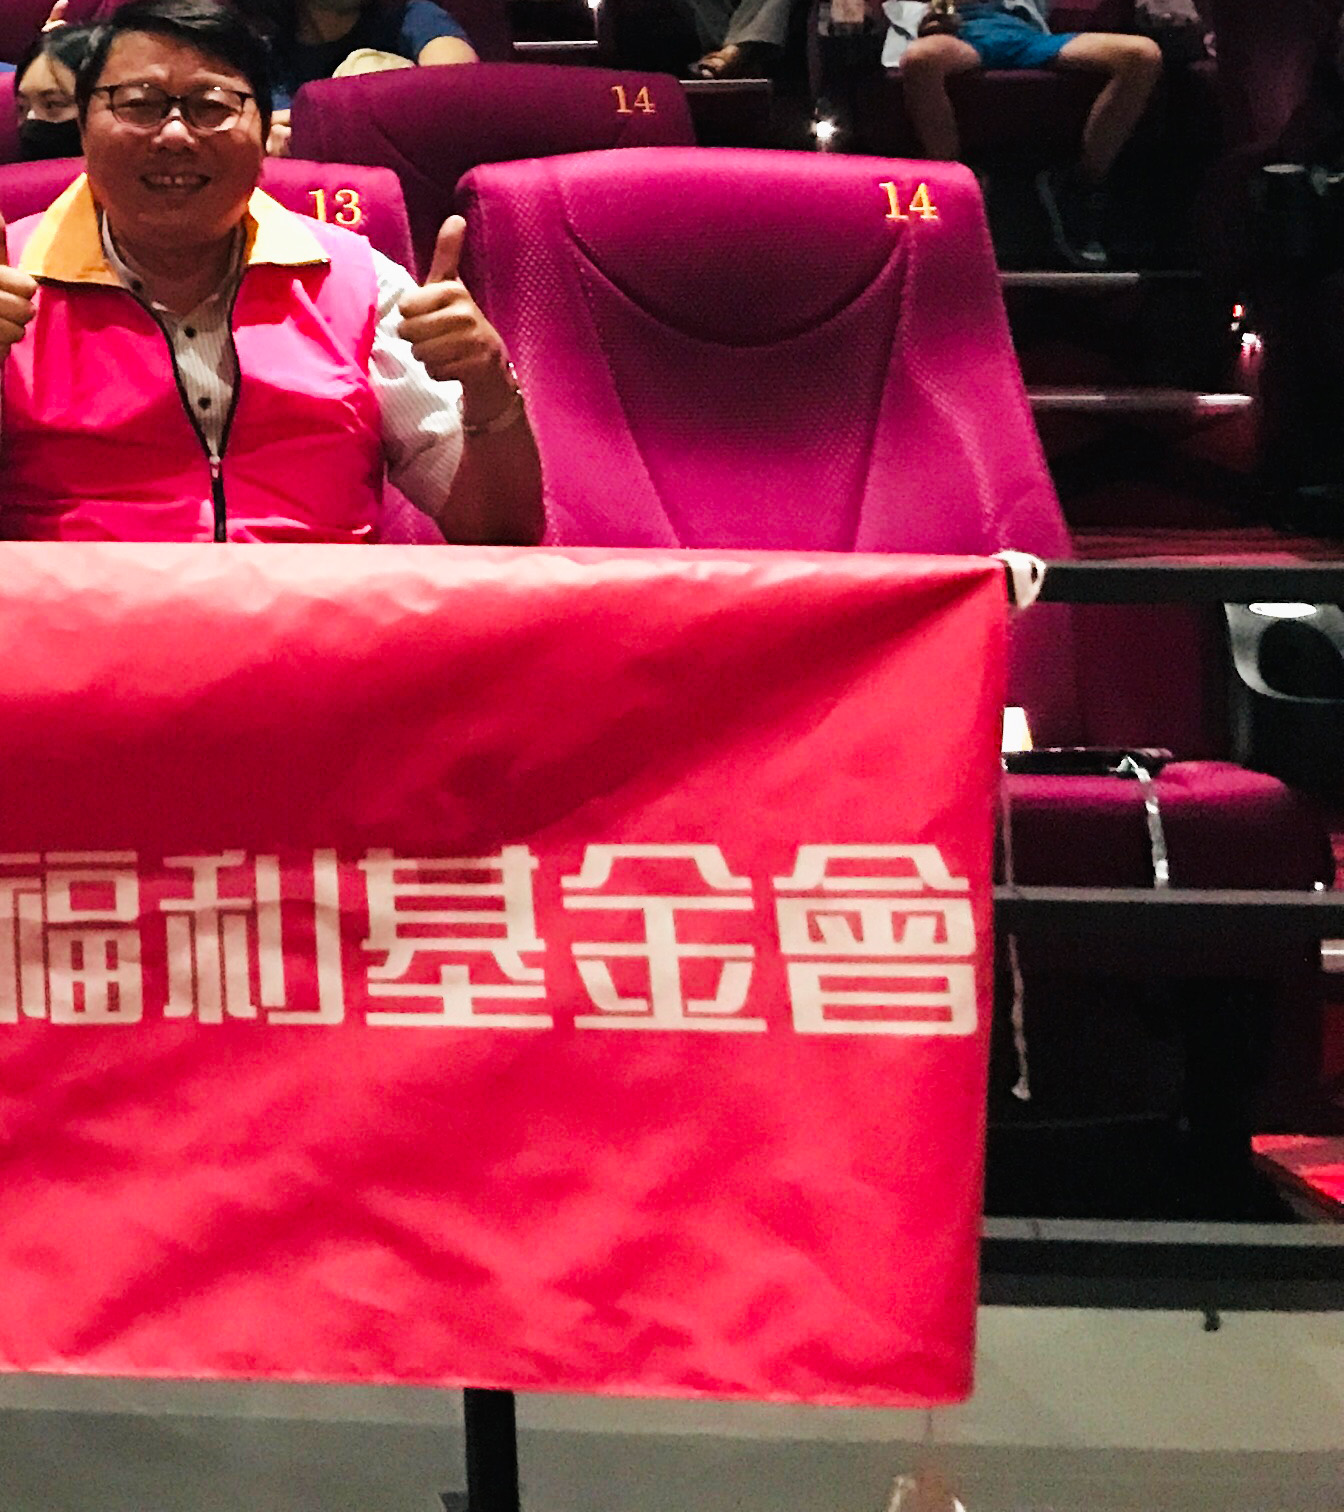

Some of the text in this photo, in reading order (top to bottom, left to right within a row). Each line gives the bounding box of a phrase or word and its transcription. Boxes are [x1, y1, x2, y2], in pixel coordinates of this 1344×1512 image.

[610, 84, 656, 115] 14
[308, 187, 362, 226] 13
[880, 181, 939, 222] 14
